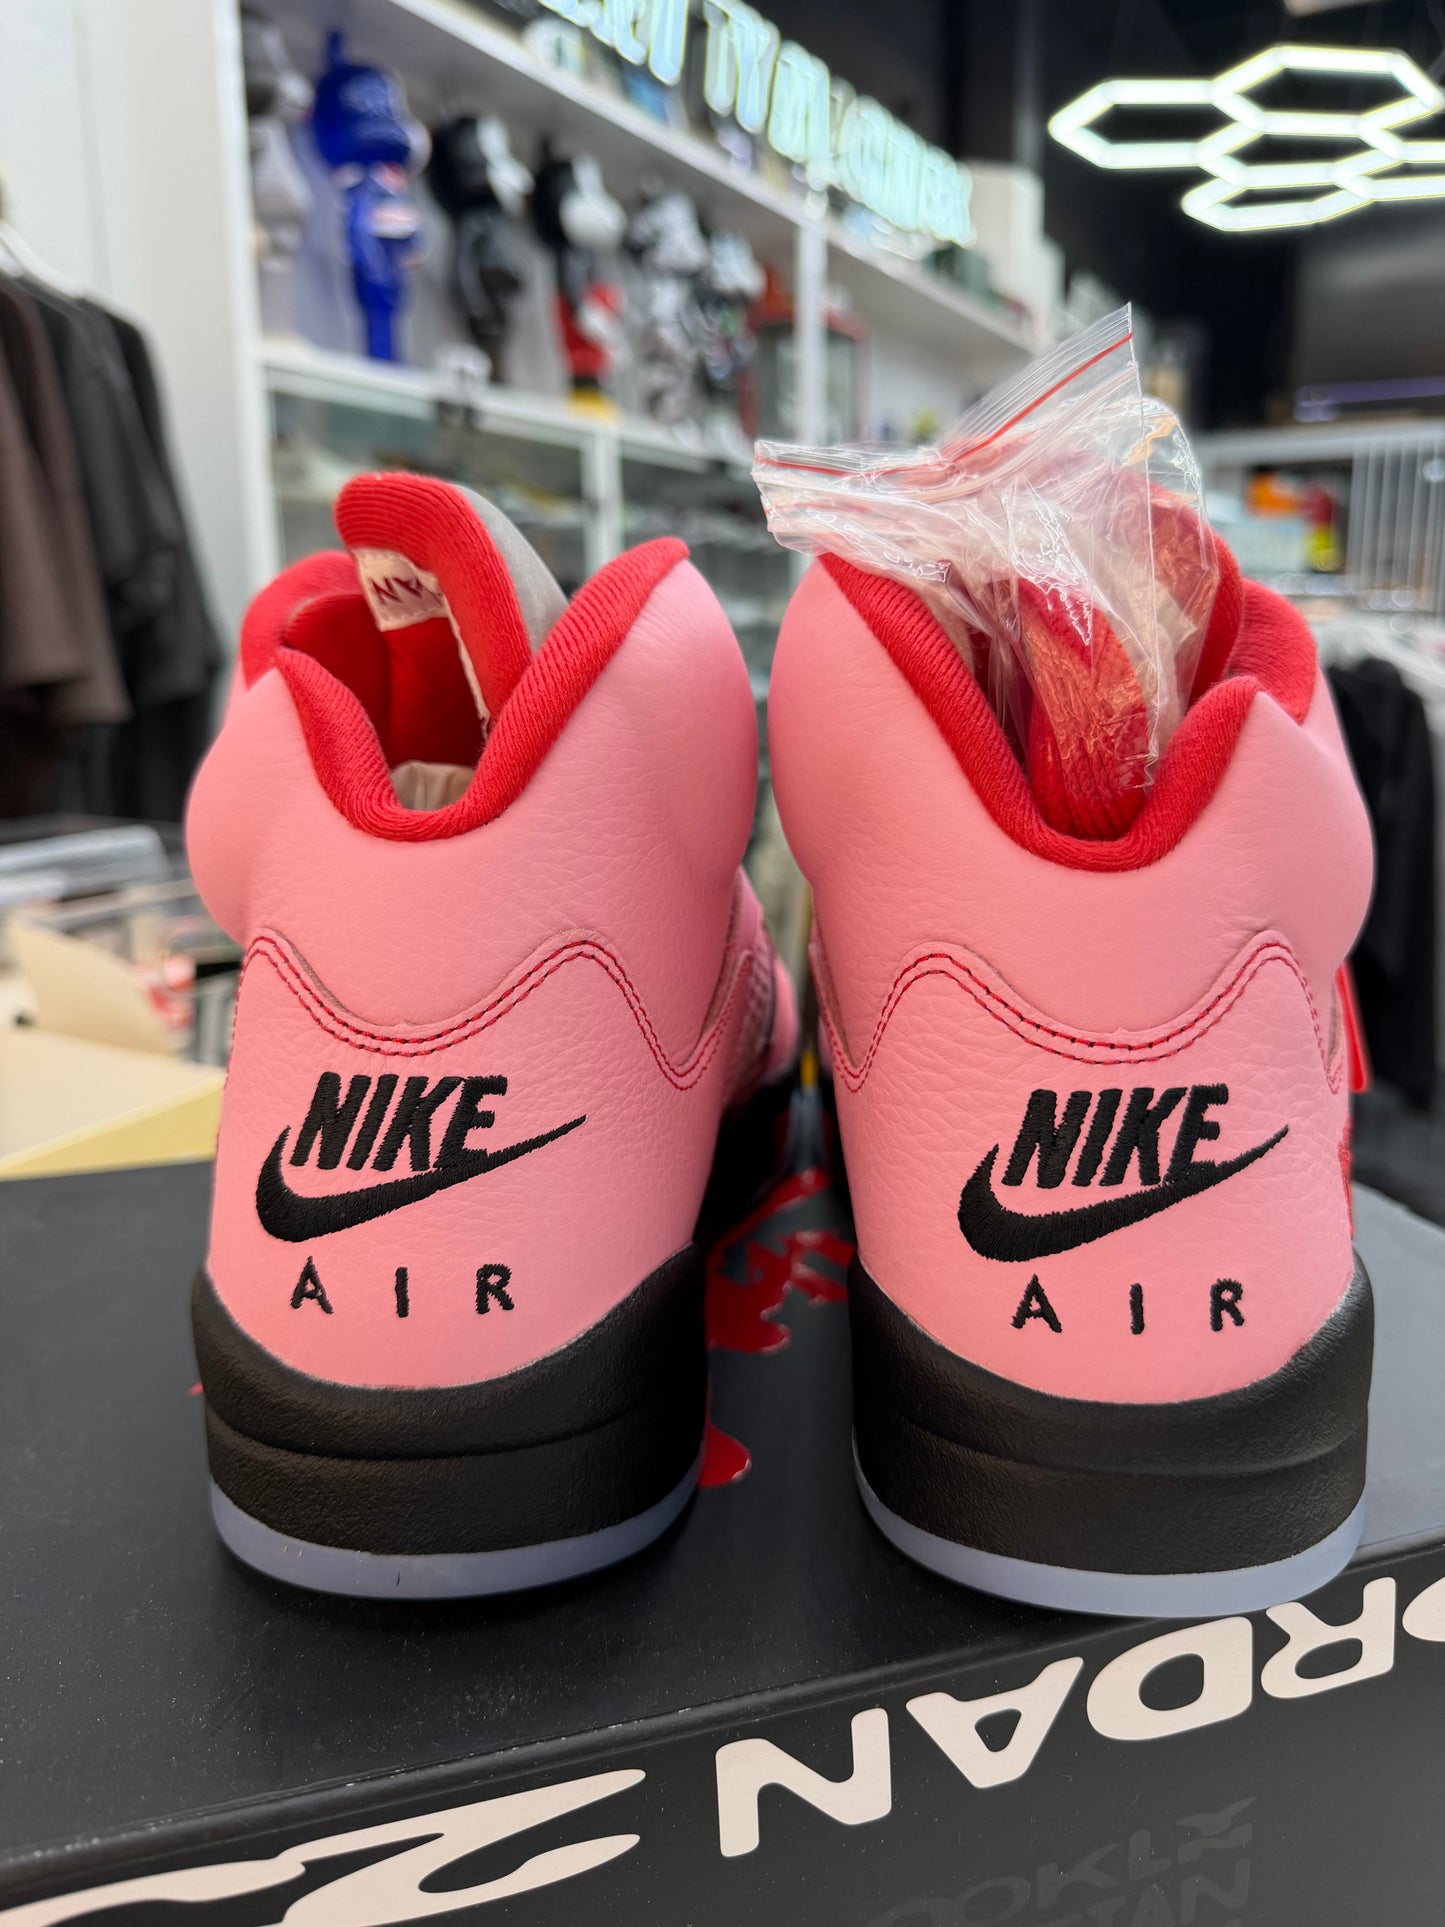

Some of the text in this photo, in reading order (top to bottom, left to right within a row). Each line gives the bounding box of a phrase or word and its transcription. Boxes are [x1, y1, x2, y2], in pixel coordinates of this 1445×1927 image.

[289, 1071, 508, 1171] NIKE
[1000, 1083, 1229, 1189] NIKE
[289, 1256, 515, 1318] AIR
[1010, 1274, 1245, 1335] AIR
[715, 1576, 1445, 1858] RDAN
